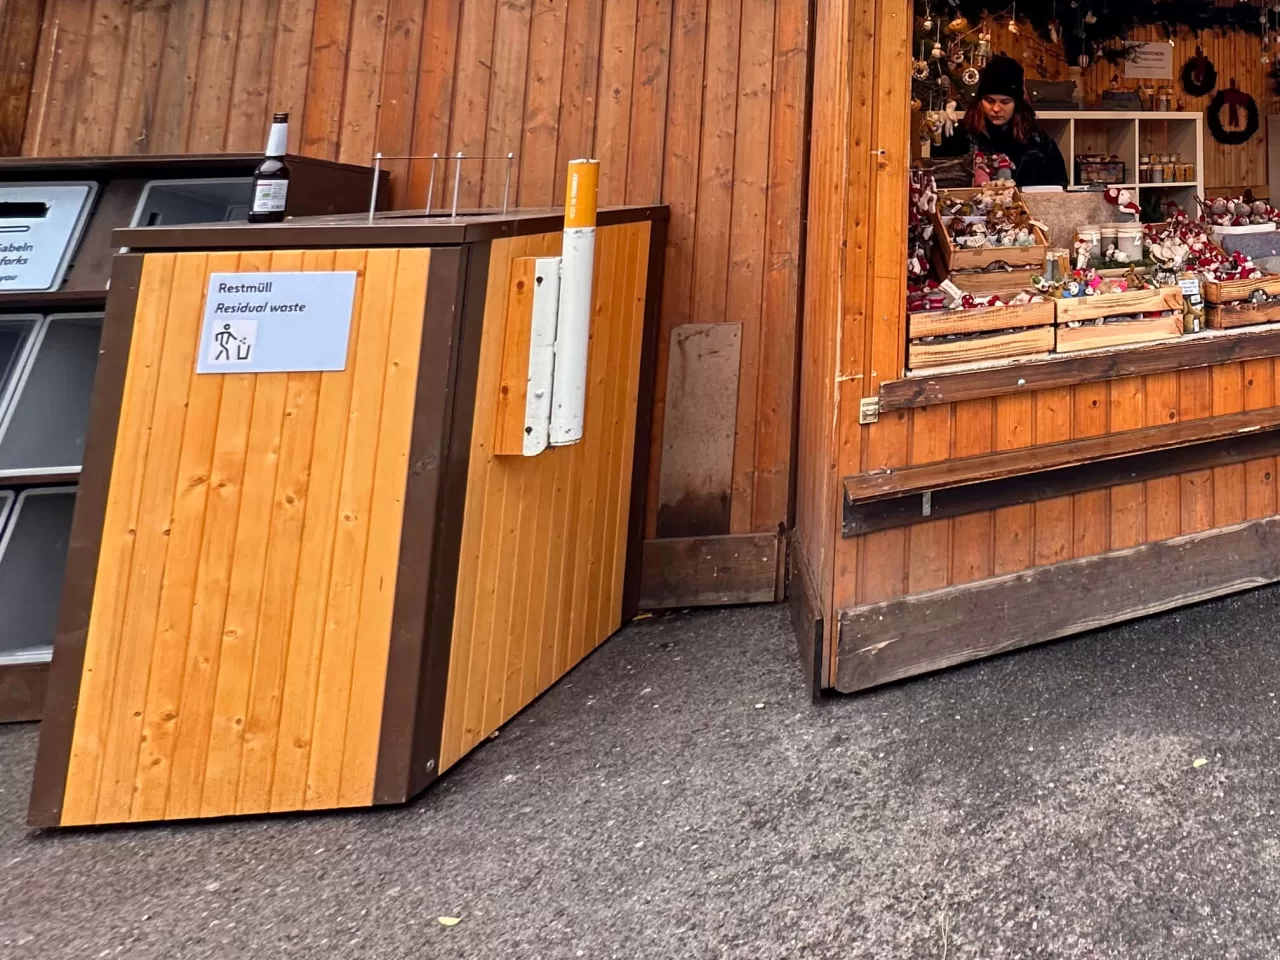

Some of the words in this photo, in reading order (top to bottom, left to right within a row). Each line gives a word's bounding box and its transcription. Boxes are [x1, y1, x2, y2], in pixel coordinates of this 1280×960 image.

[218, 282, 272, 293] Restmüll
[215, 302, 268, 314] Residual
[270, 303, 306, 313] waste
